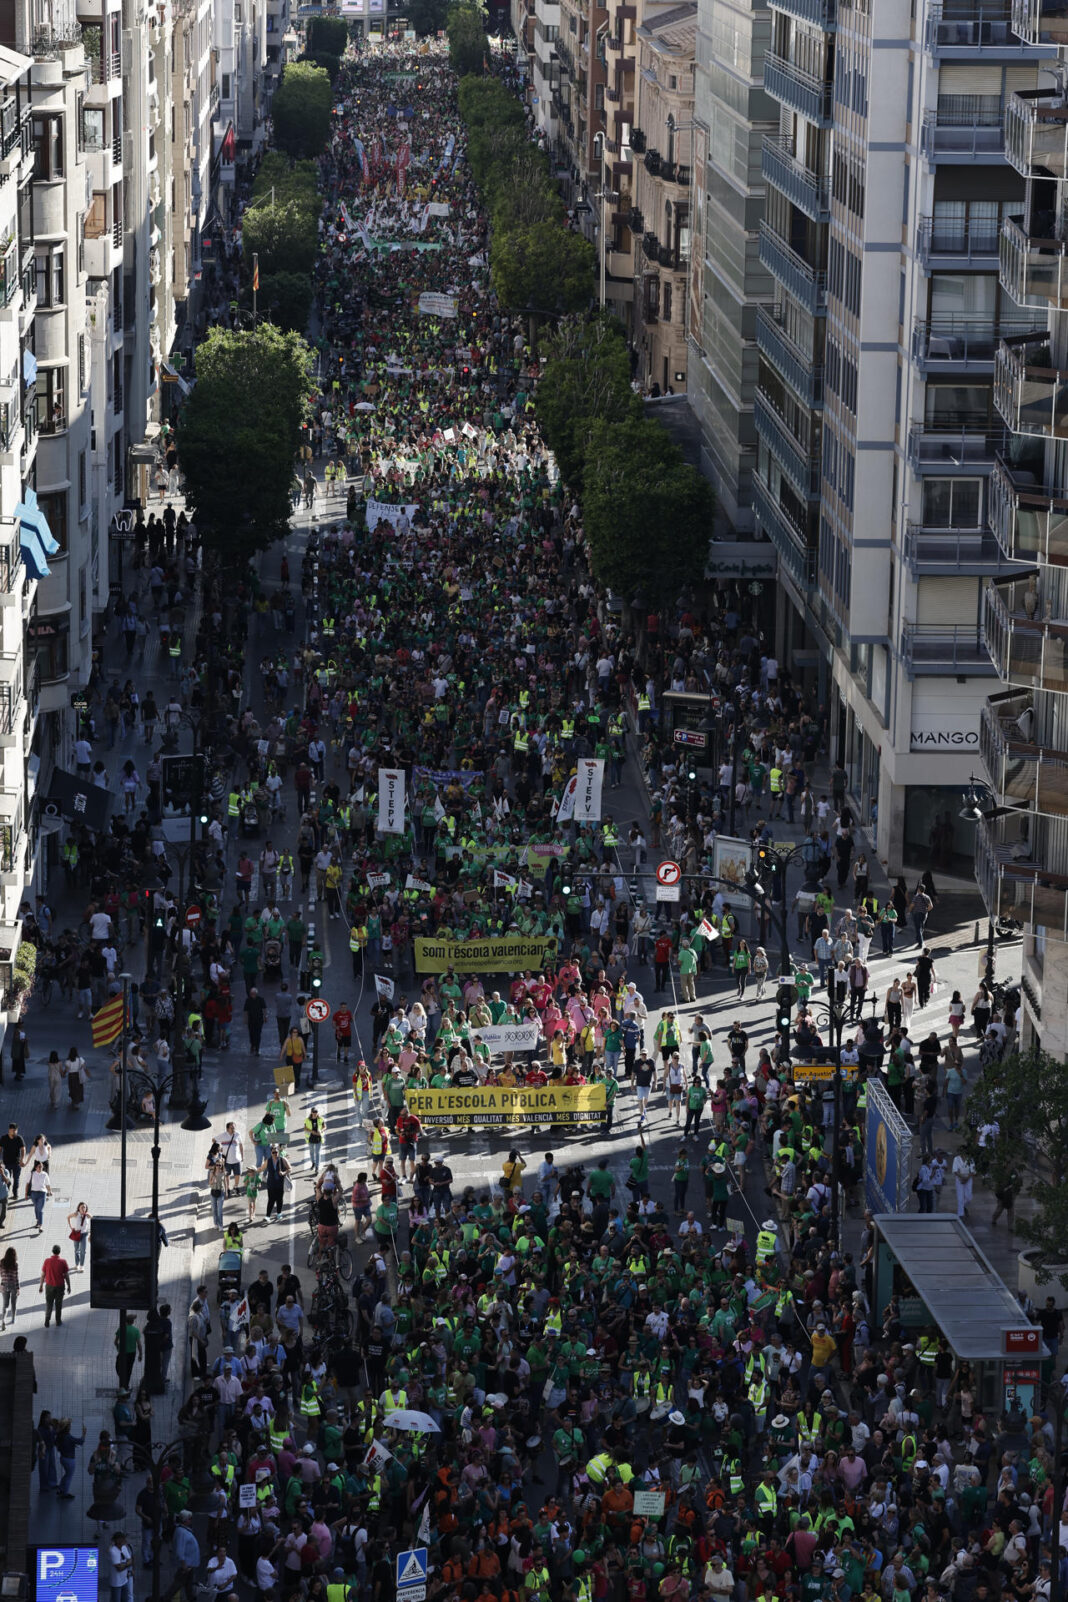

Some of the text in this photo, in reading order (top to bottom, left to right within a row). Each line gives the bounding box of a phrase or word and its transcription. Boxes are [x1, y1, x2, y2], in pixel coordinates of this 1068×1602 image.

[910, 731, 979, 744] MANGO
[584, 768, 595, 813] STEPV
[387, 780, 396, 828] STEPV
[491, 944, 547, 957] valencian
[409, 1096, 433, 1110] PER
[437, 1093, 497, 1109] L'ESCOLA
[501, 1091, 557, 1108] PÚBLICA
[424, 1114, 454, 1124] INVERSIÓ
[456, 1113, 471, 1124] MÉS
[473, 1114, 503, 1124] QUALITAT
[506, 1113, 520, 1123] MÉS
[556, 1111, 571, 1122] MÉS
[573, 1111, 602, 1121] DIGNITAT
[40, 1550, 65, 1581] P
